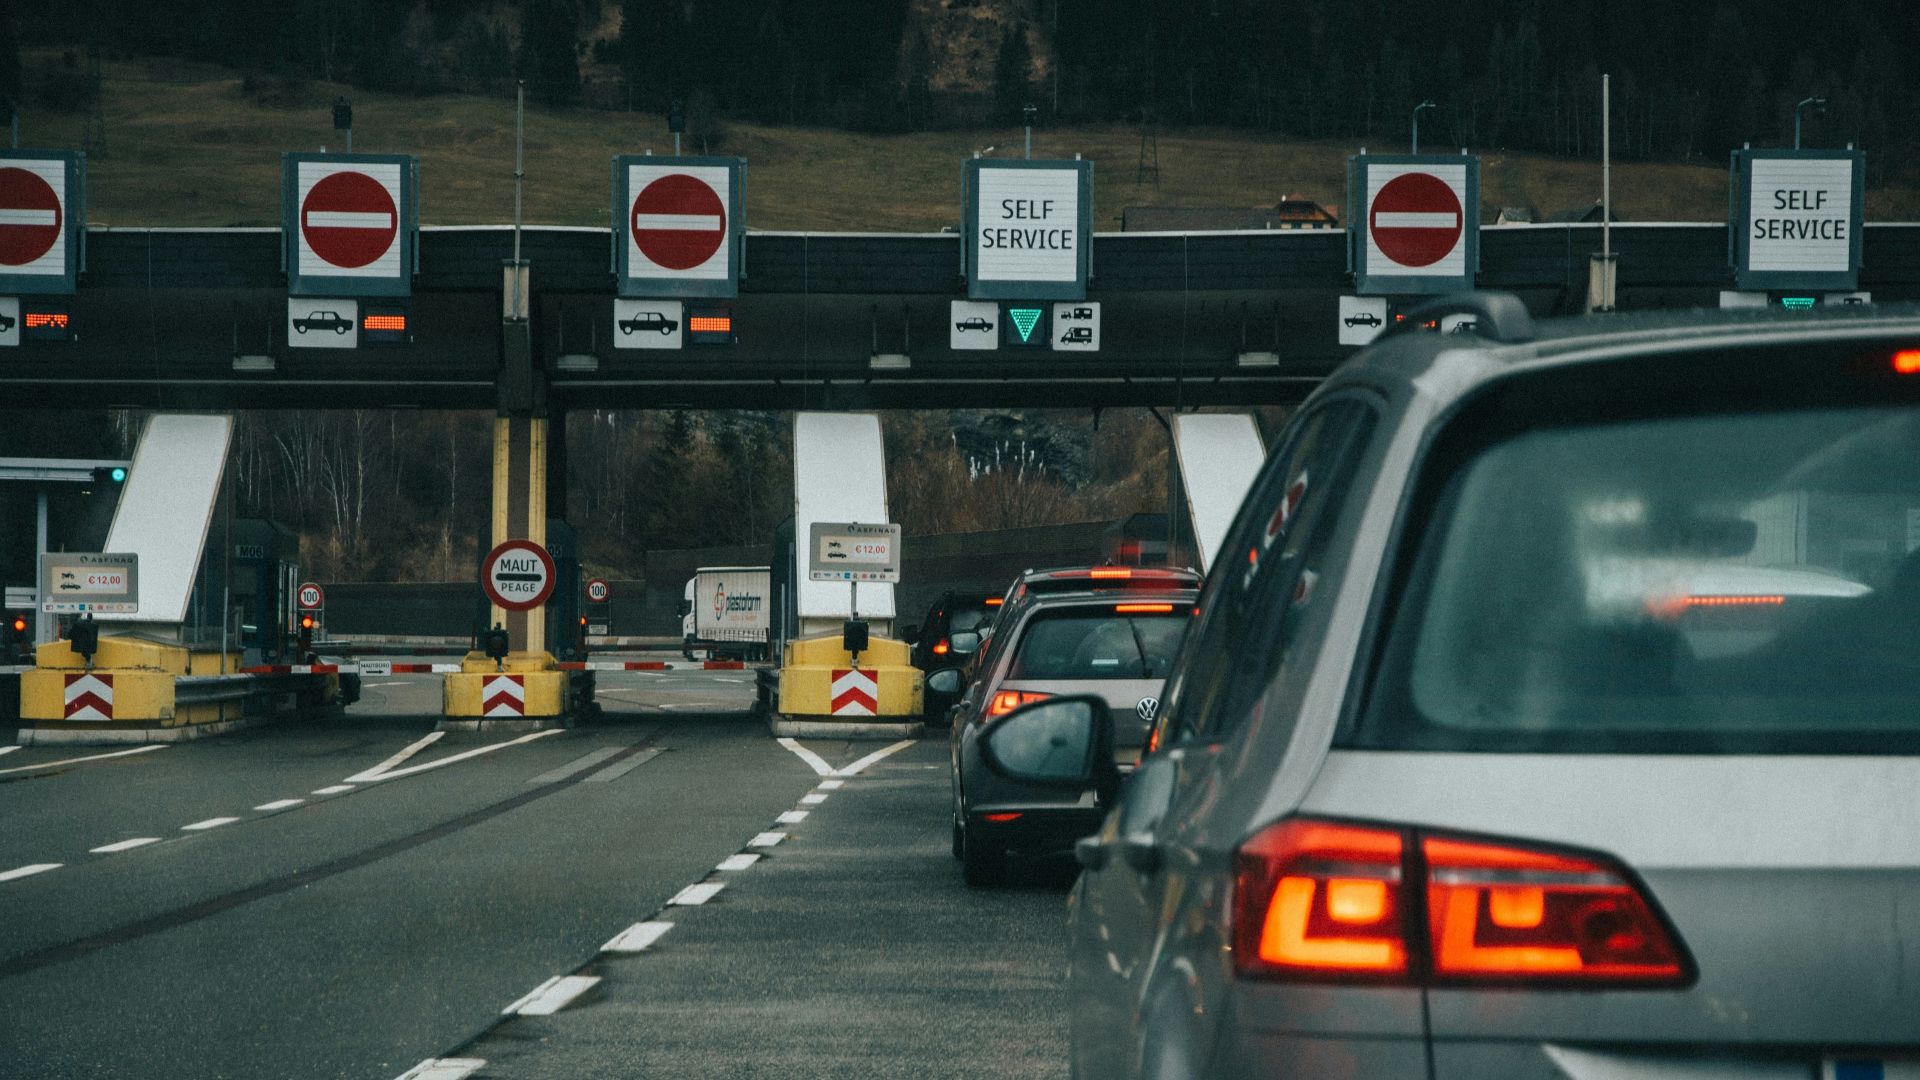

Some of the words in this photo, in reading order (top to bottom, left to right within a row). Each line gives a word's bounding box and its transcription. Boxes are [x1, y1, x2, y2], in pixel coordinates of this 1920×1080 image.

[1774, 189, 1828, 210] SELF
[1002, 199, 1054, 220] SELF
[1754, 219, 1846, 240] SERVICE
[982, 228, 1073, 250] SERVICE
[500, 559, 537, 572] MAUT
[501, 582, 536, 592] PEAGE
[591, 585, 605, 596] 100
[303, 591, 317, 602] 100
